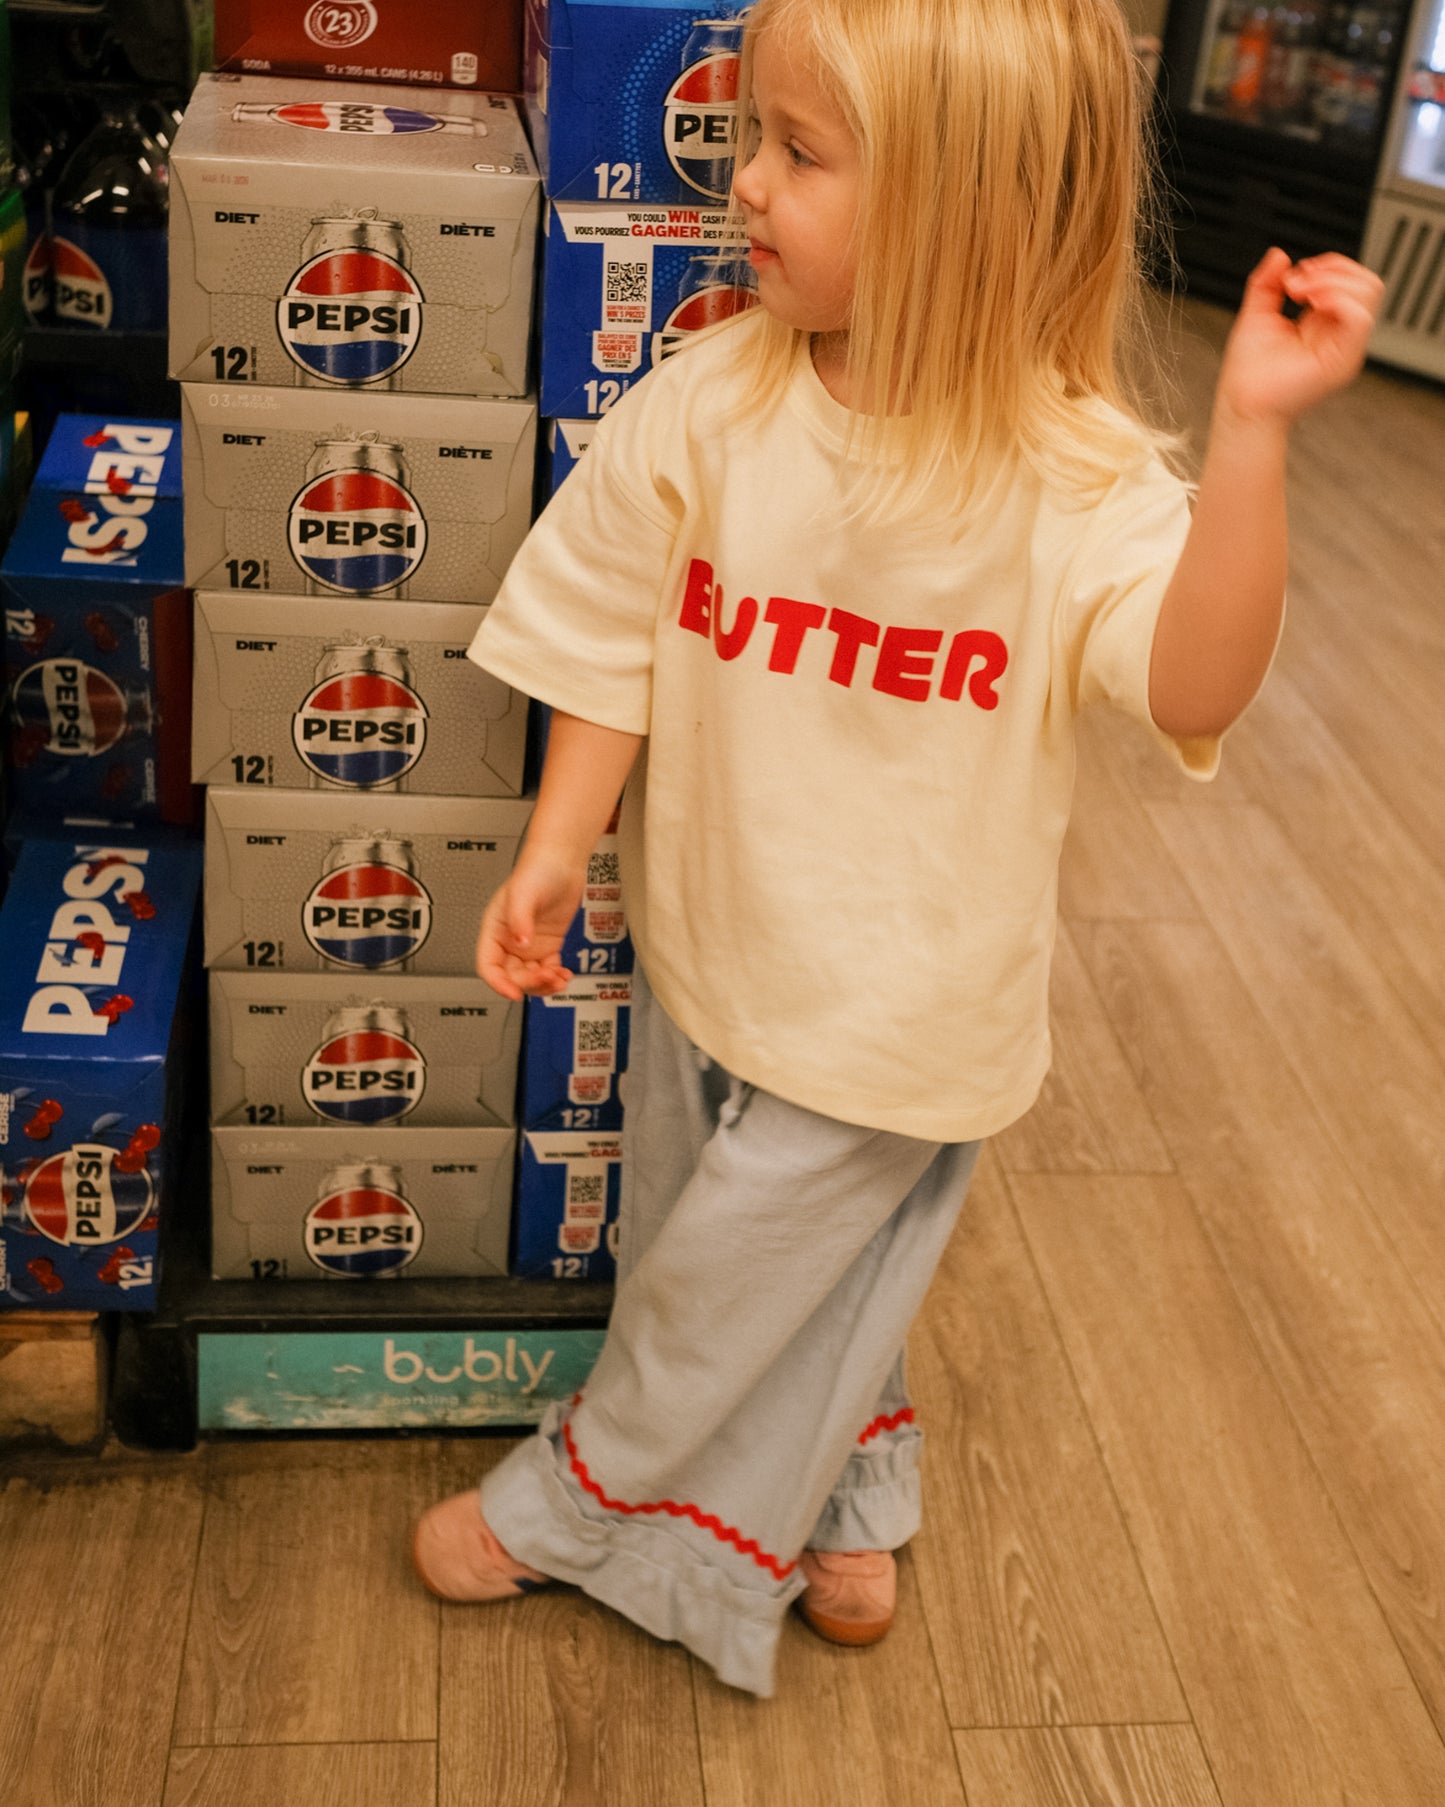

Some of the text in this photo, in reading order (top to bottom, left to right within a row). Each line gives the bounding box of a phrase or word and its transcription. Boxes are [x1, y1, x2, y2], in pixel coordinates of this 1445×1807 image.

[325, 8, 353, 36] 23
[242, 58, 271, 70] SODA
[324, 64, 337, 74] 12
[345, 65, 363, 76] 355
[380, 67, 408, 79] CANS
[340, 103, 374, 133] PEPSI
[594, 162, 633, 200] 12
[214, 211, 260, 225] DIET
[627, 213, 642, 222] YOU
[643, 213, 667, 223] COULD
[668, 210, 699, 224] WIN
[701, 215, 721, 224] CASH
[440, 223, 495, 237] DIÈTE
[574, 226, 593, 235] VOUS
[595, 226, 629, 237] POURRIEZ
[631, 224, 701, 238] GAGNER
[703, 230, 717, 239] DES
[28, 276, 104, 315] PPSI
[288, 302, 410, 334] PEPSI
[211, 346, 248, 381] 12
[584, 379, 620, 414] 12
[222, 433, 266, 446] DIET
[438, 446, 493, 460] DIÈTE
[61, 424, 173, 566] PEPSI
[299, 519, 416, 549] PEPSI
[226, 559, 261, 589] 12
[5, 608, 36, 636] 12
[235, 640, 277, 652] DIET
[678, 558, 1008, 711] BUTTER
[55, 665, 81, 749] PEPSI
[302, 718, 416, 745] PEPSI
[231, 755, 265, 784] 12
[246, 835, 286, 846] DIET
[447, 839, 497, 851] DIÈTE
[312, 906, 422, 930] PEPSI
[21, 845, 149, 1036] PEPSI
[243, 941, 275, 967] 12
[577, 948, 609, 973] 12
[599, 991, 630, 1001] GAG
[249, 1005, 287, 1015] DIET
[311, 1070, 416, 1091] PEPSI
[245, 1105, 277, 1126] 12
[561, 1108, 592, 1129] 12
[591, 1149, 622, 1158] GAG
[247, 1165, 285, 1175] DIET
[76, 1151, 103, 1238] PEPSI
[313, 1225, 413, 1245] PEPSI
[118, 1262, 153, 1291] 12
[250, 1259, 280, 1279] 12
[552, 1257, 582, 1278] 12
[383, 1338, 555, 1394] bubly
